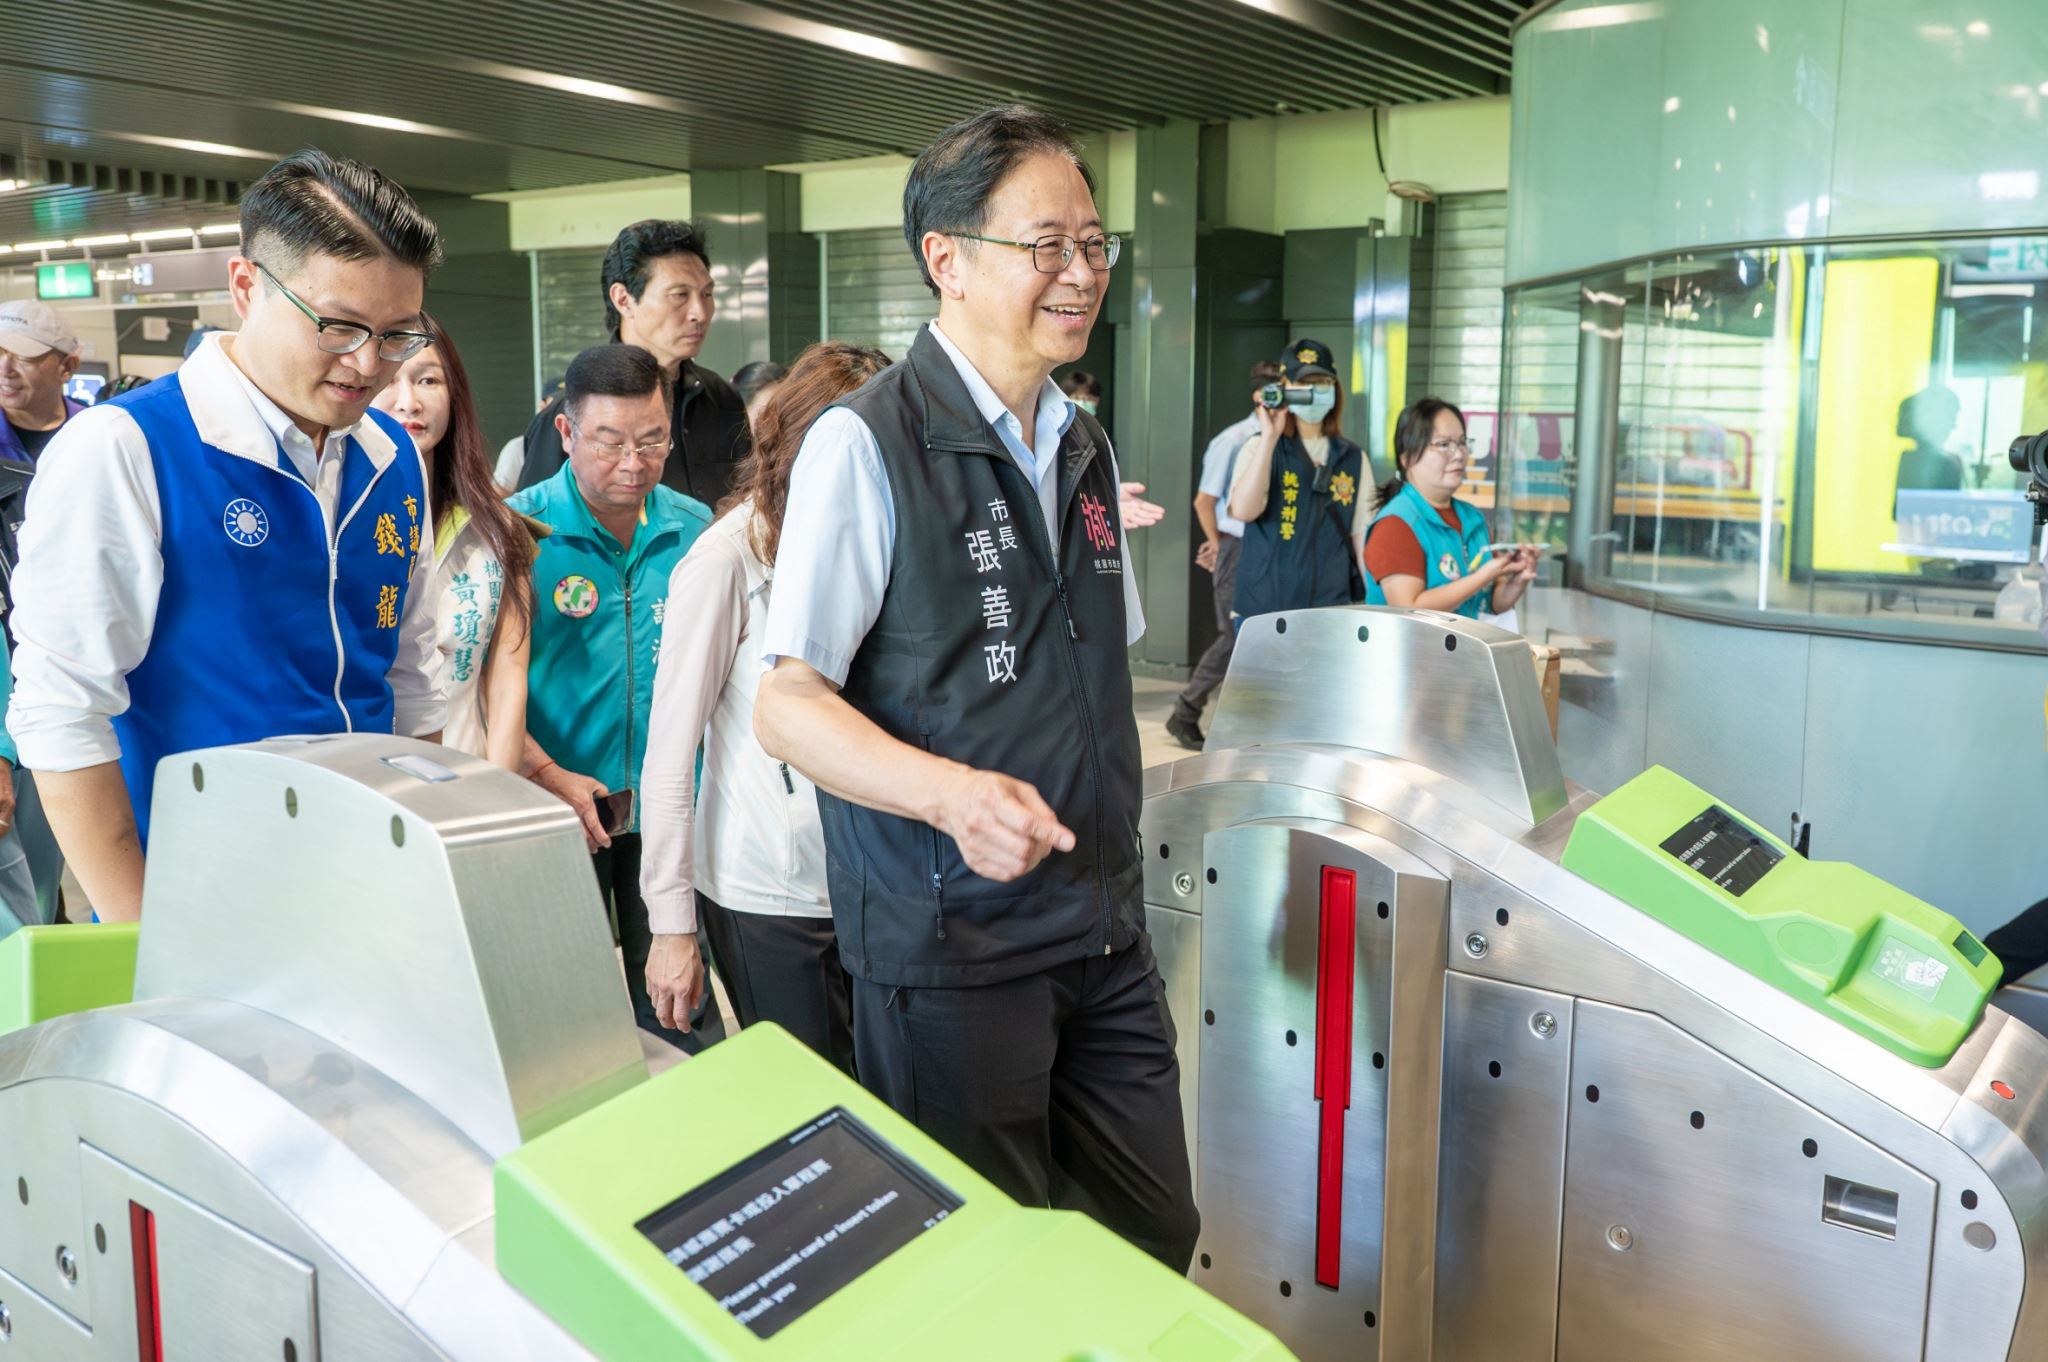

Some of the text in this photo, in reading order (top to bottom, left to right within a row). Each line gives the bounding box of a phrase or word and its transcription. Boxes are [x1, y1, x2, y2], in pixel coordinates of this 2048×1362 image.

[373, 512, 405, 629] 錢龍
[987, 497, 1018, 551] 市長
[450, 572, 482, 682] 黃瓊慧
[965, 529, 1018, 684] 張善政
[756, 1253, 803, 1288] present
[799, 1235, 827, 1258] card
[823, 1229, 839, 1243] or
[833, 1209, 870, 1234] insert
[770, 1282, 797, 1304] you
